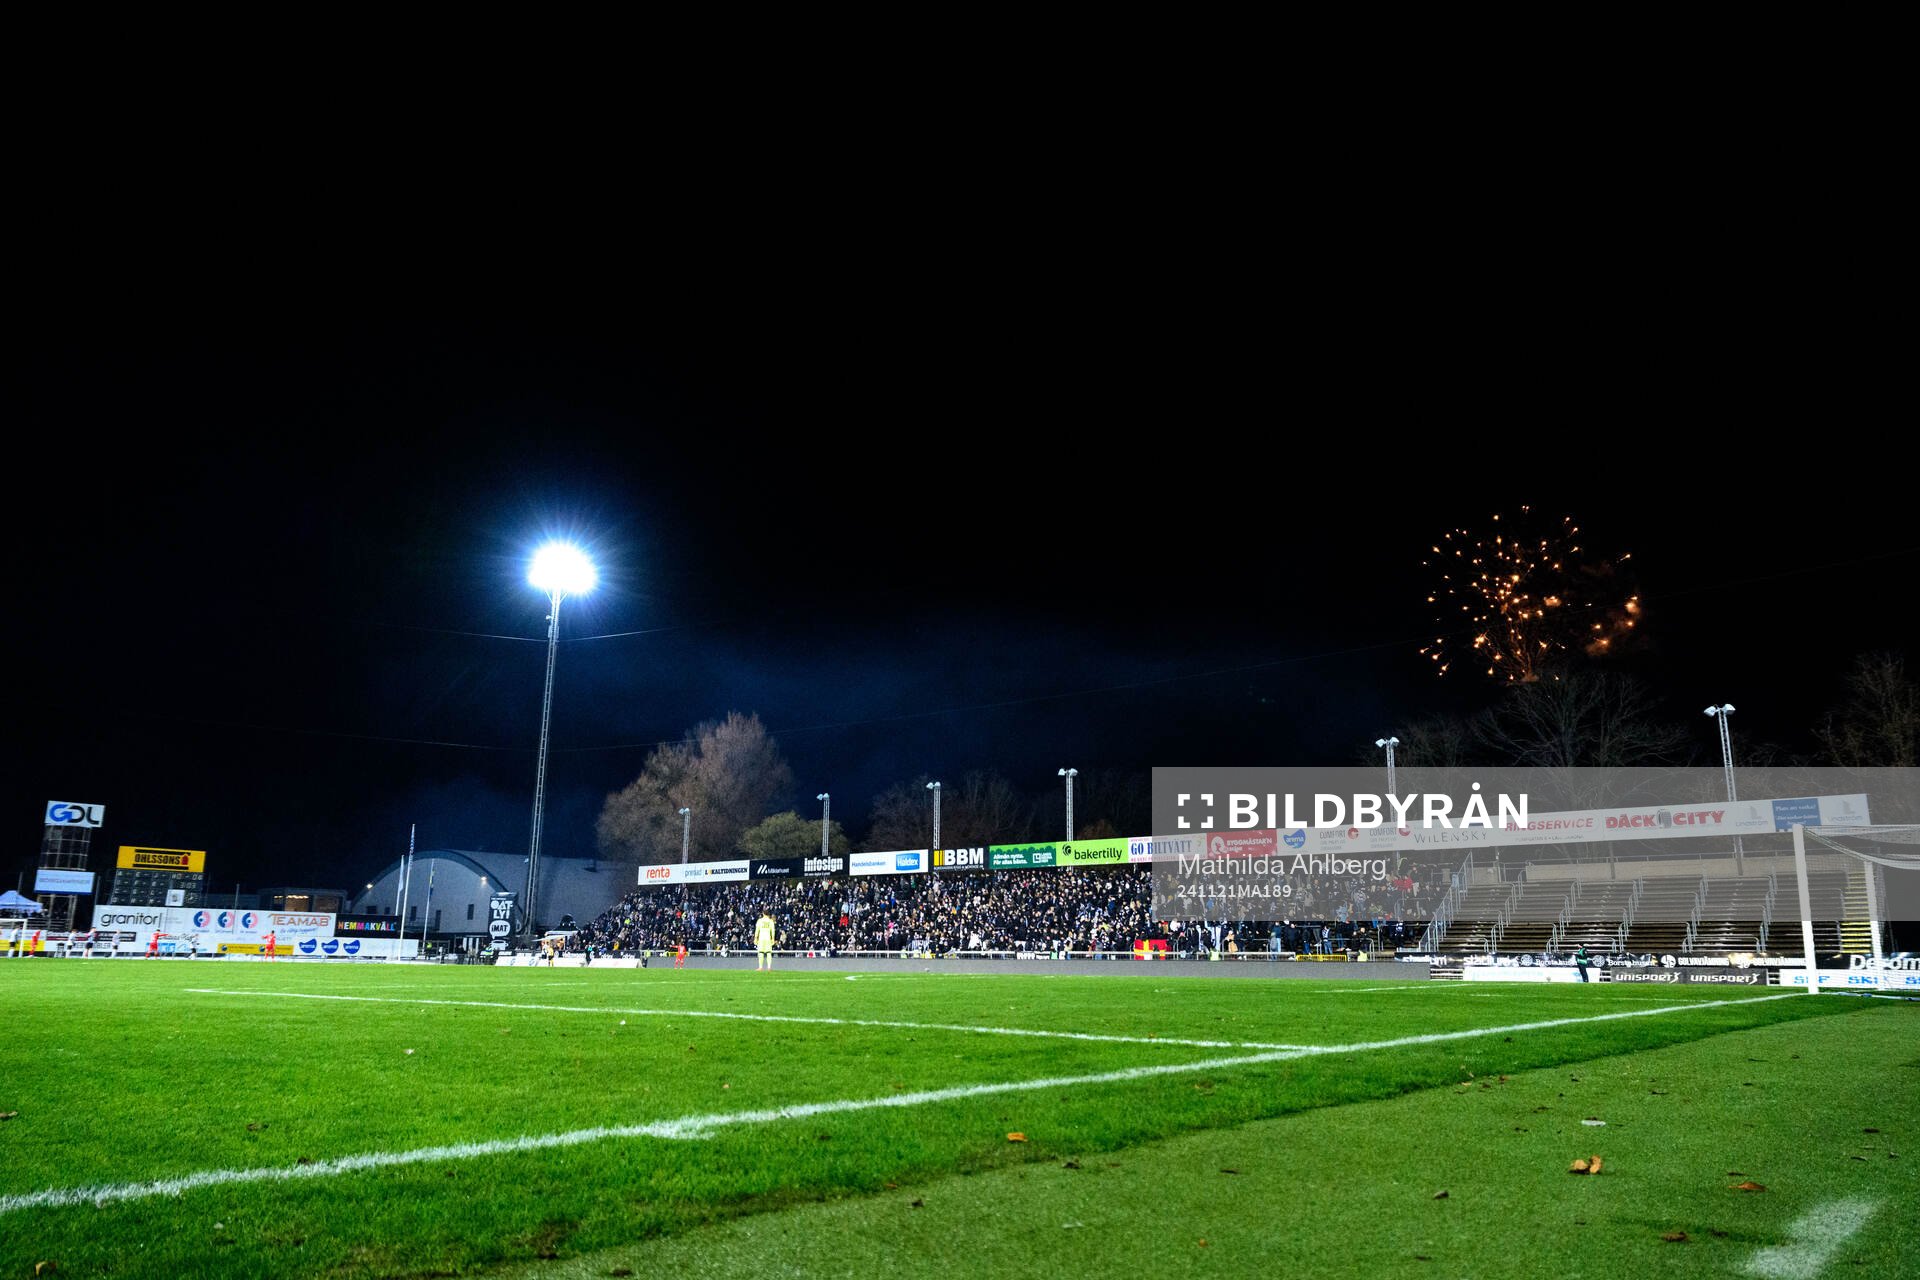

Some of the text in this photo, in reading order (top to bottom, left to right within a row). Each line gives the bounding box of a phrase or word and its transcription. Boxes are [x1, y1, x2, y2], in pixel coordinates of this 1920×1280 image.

[50, 804, 100, 824] GDL
[1605, 810, 1725, 828] DÄCK CITY
[1074, 848, 1123, 861] bakertilly
[1131, 839, 1192, 855] GO BILTVÄTT
[804, 857, 843, 873] infosign
[945, 848, 984, 866] BBM
[646, 862, 671, 879] renta
[101, 913, 158, 927] granitor
[337, 921, 395, 931] HEMMAKVÄLL
